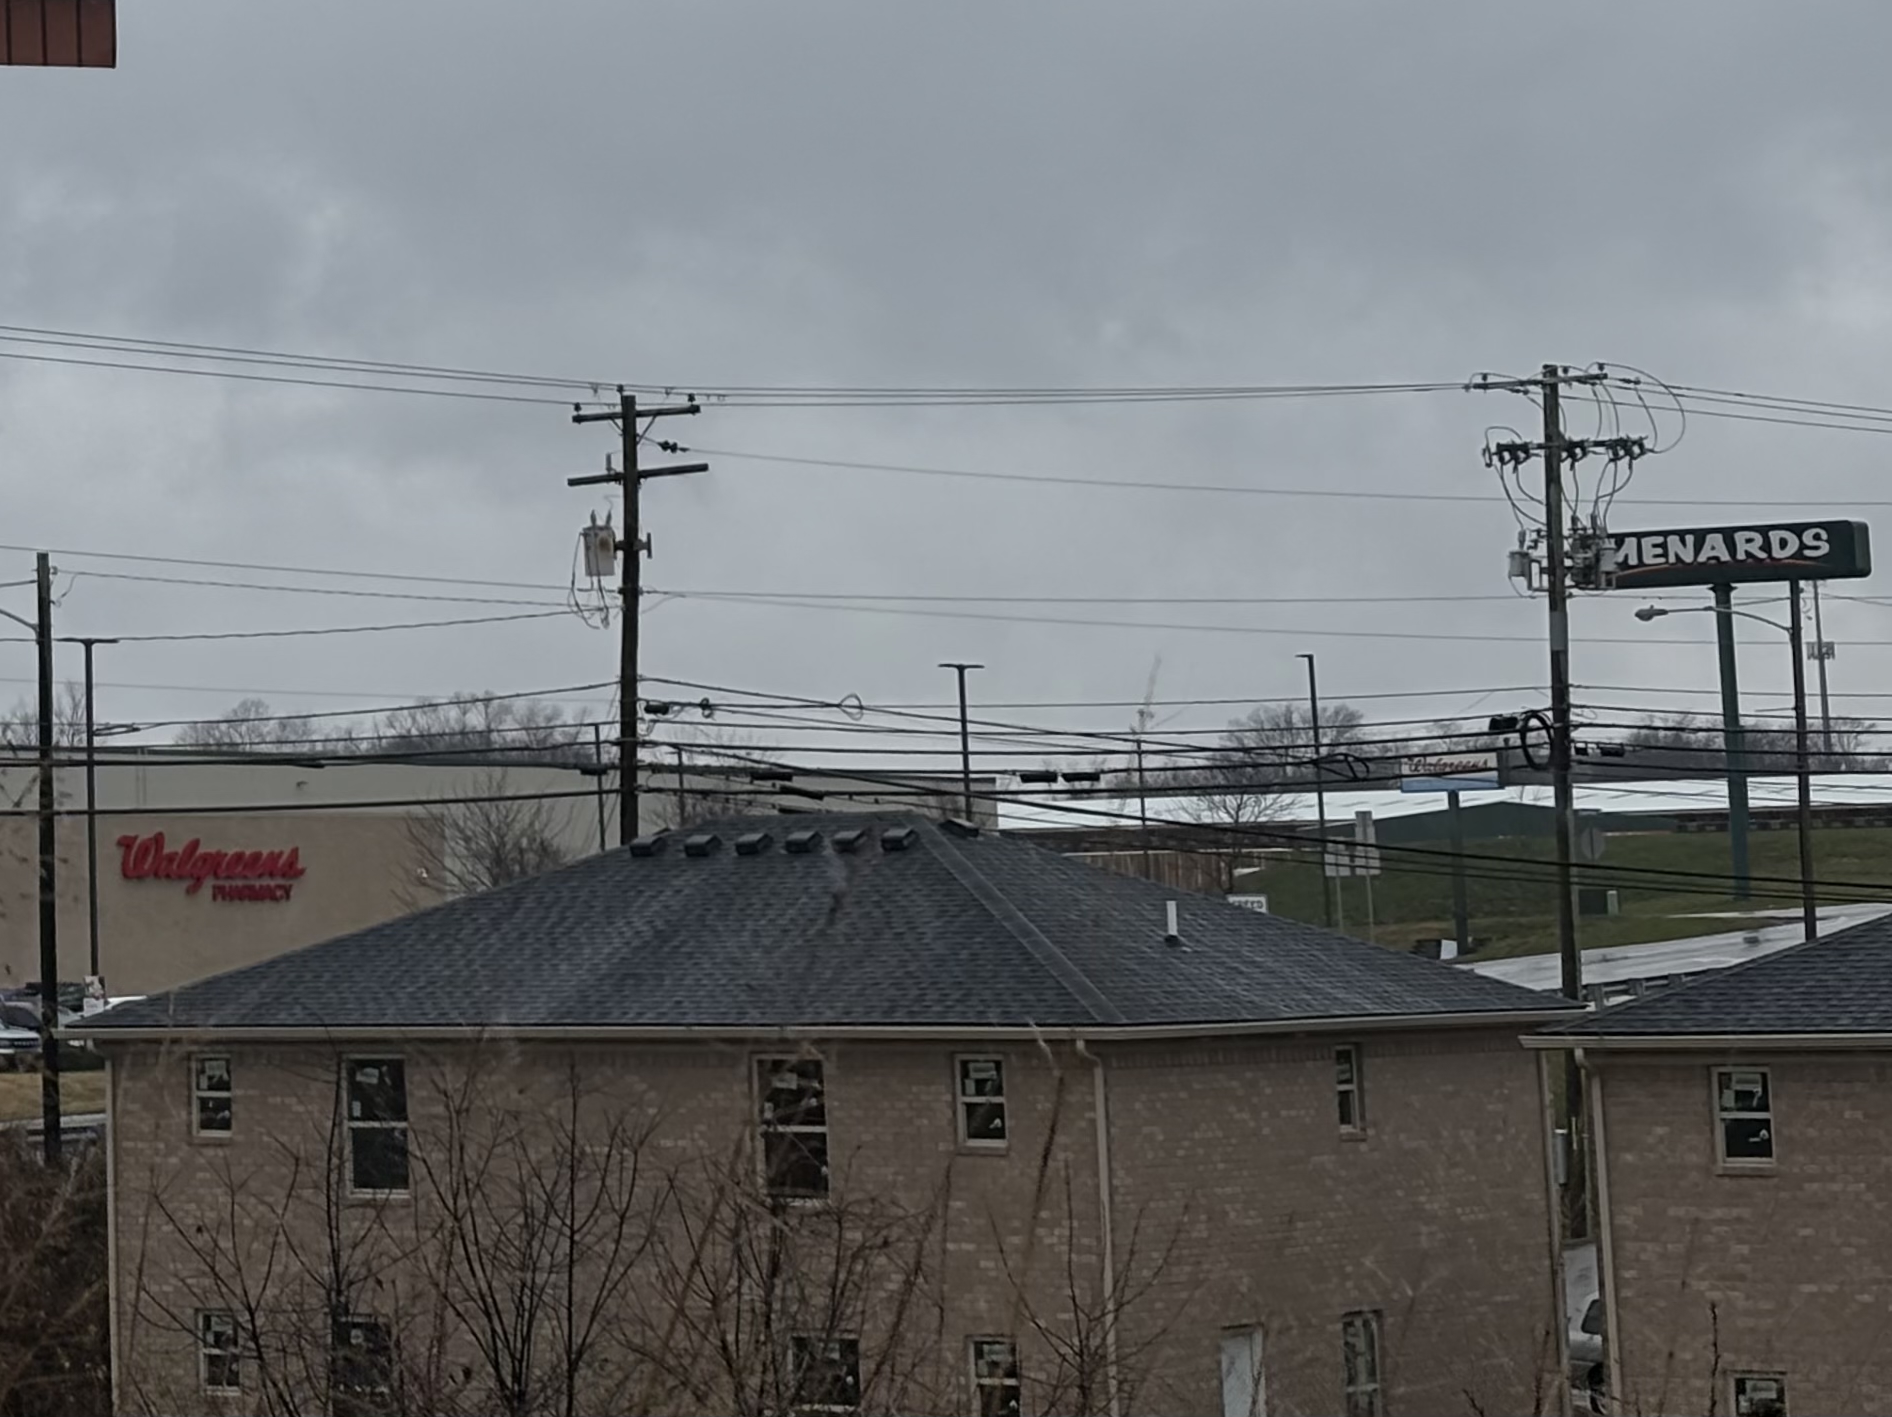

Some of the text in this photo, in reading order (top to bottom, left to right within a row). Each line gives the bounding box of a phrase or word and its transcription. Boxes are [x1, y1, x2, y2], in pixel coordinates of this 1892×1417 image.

[1613, 528, 1830, 566] MENARDS
[116, 832, 307, 896] Walgreens
[211, 884, 293, 902] PHARMACY
